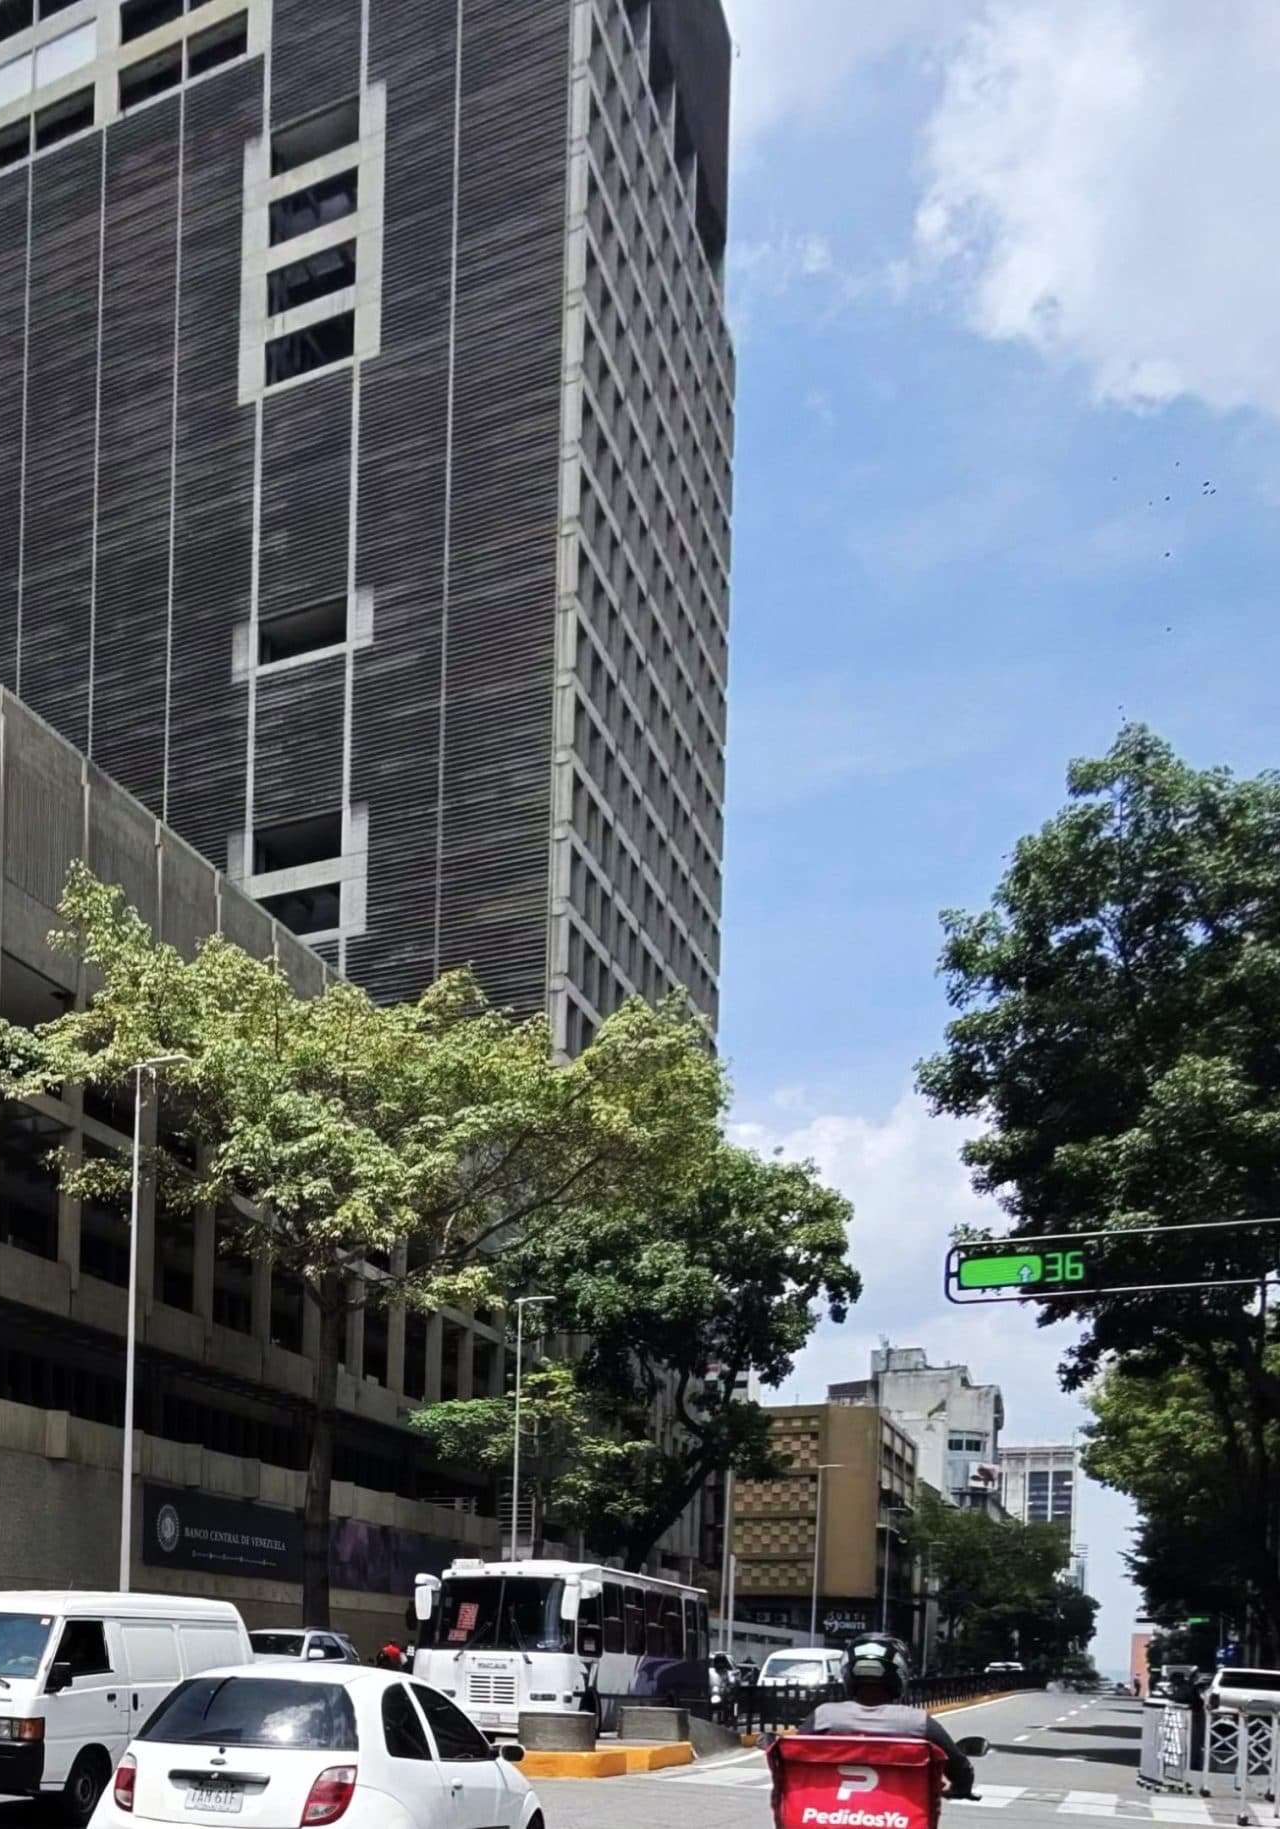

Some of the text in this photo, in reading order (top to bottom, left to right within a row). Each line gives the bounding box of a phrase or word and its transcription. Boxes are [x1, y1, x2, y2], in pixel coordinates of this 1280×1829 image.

[1044, 1250, 1084, 1282] 36
[184, 1526, 287, 1551] BANCO CENTRAL DE VENEZUELA
[836, 1764, 879, 1801] P
[802, 1807, 910, 1829] PedidosYa
